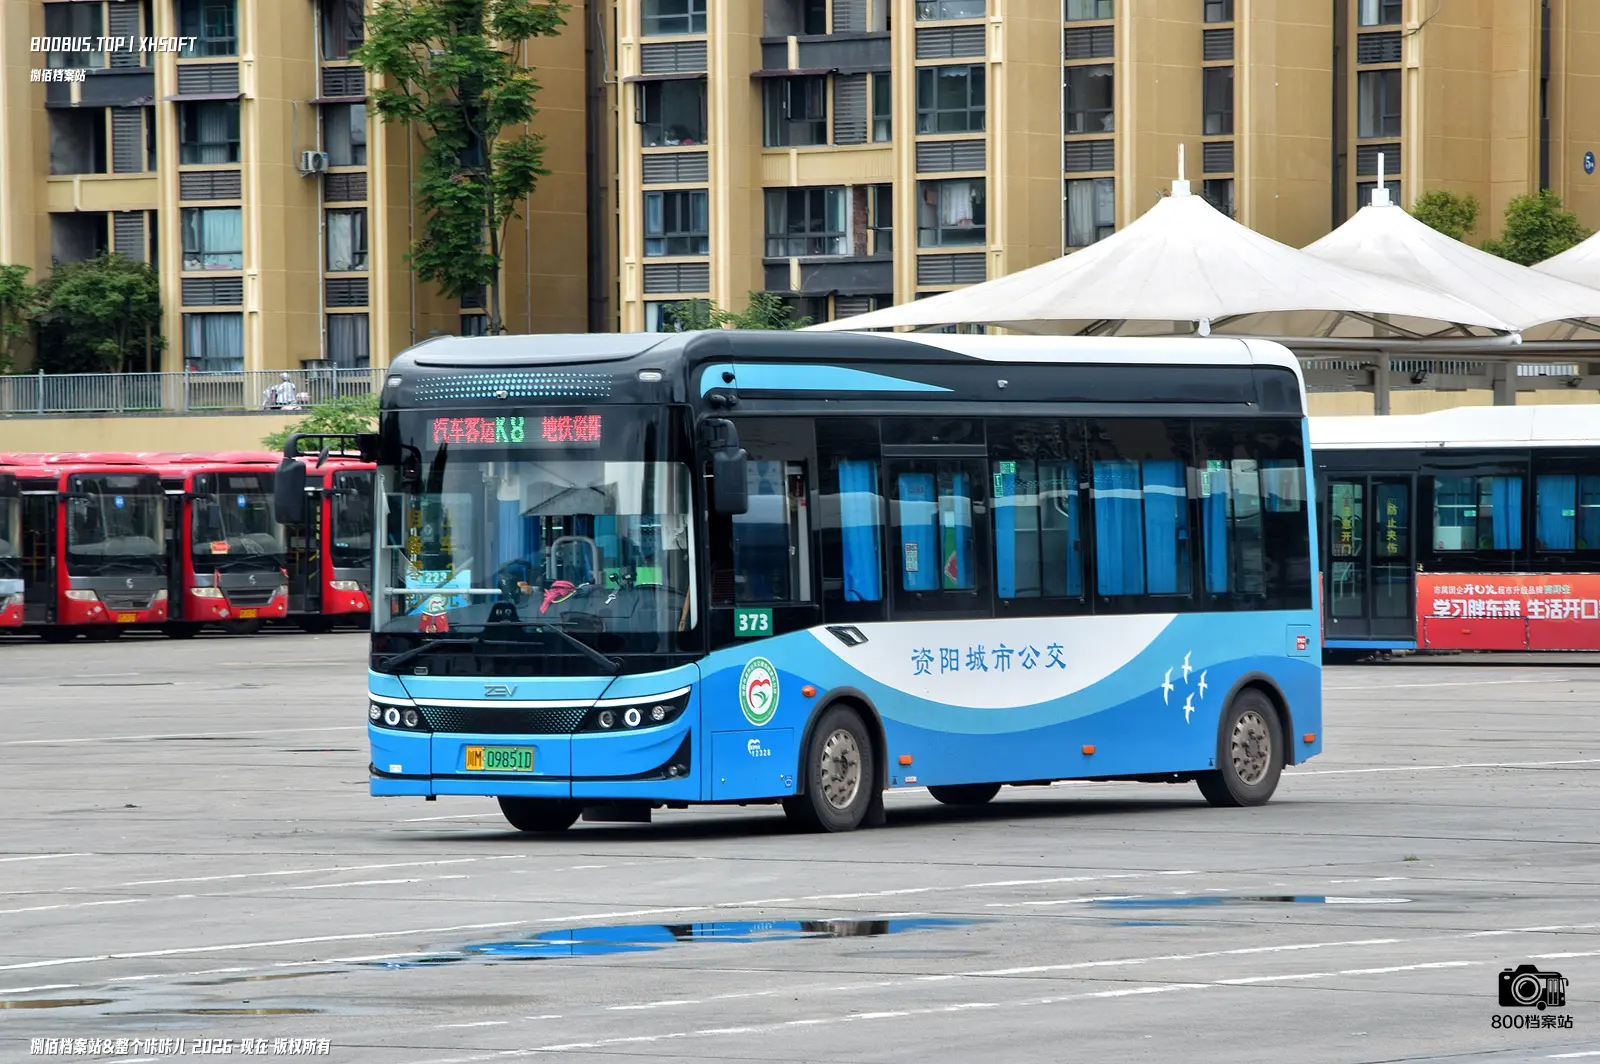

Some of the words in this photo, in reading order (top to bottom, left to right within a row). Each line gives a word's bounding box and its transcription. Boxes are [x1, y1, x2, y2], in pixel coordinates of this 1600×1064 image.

[495, 416, 525, 443] K8
[1433, 598, 1521, 619] 学习胖东来
[1526, 598, 1600, 619] 生活开口
[739, 613, 768, 631] 373
[911, 642, 1067, 676] 资阳城市公交
